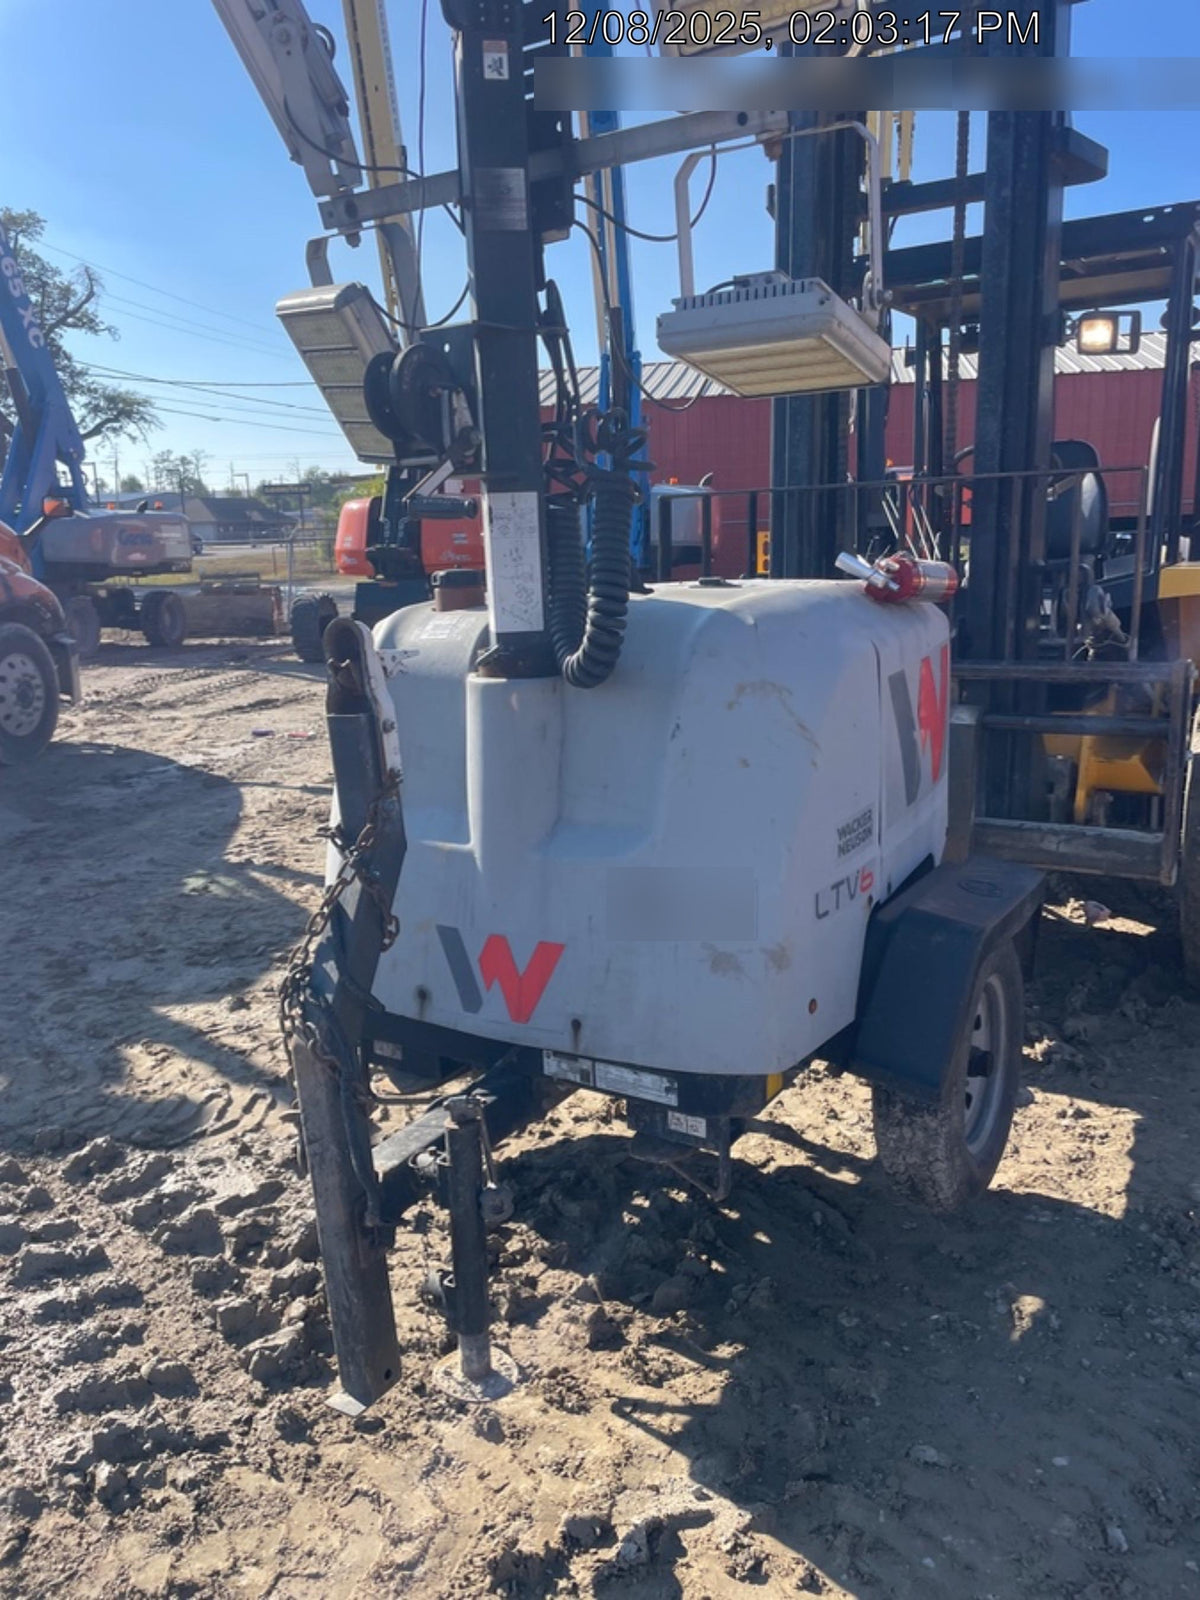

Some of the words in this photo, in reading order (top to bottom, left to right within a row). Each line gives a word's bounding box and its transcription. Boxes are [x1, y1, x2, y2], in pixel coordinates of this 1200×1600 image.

[17, 303, 45, 349] XC
[836, 808, 873, 841] WACKER
[837, 826, 873, 858] NEUSON
[814, 865, 874, 920] LTV6
